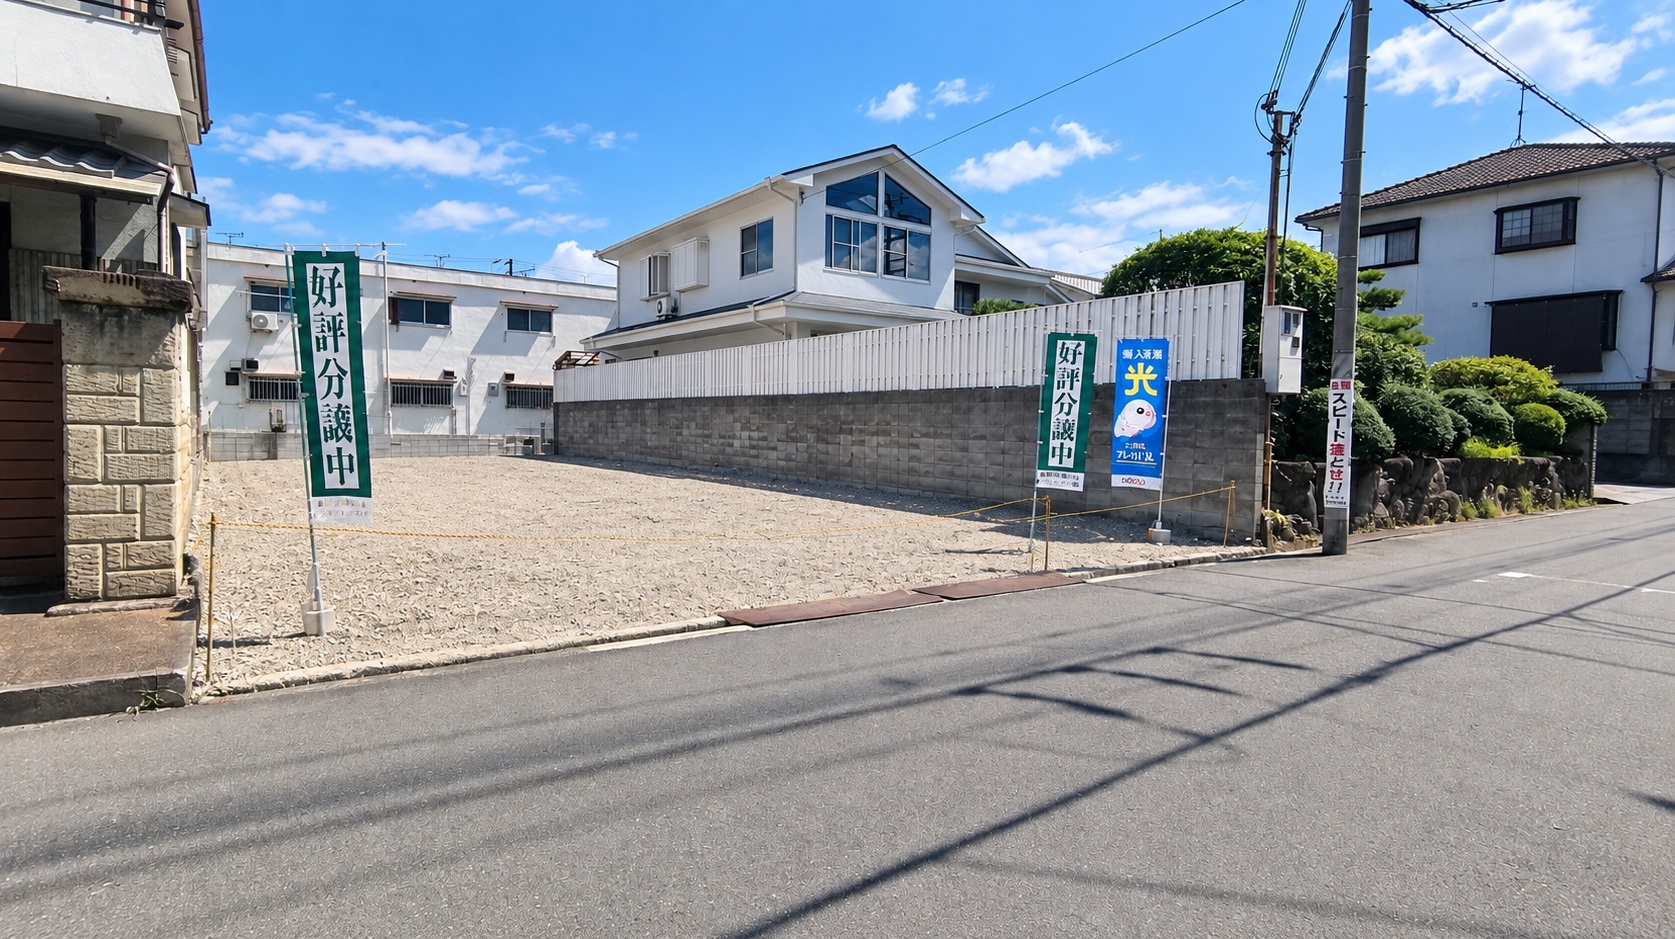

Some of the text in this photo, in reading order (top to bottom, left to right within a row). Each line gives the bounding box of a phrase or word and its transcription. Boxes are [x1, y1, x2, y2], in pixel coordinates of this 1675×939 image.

[309, 265, 355, 486] 好評分譲中
[1051, 341, 1083, 466] 好評分譲中
[1124, 362, 1158, 397] 光
